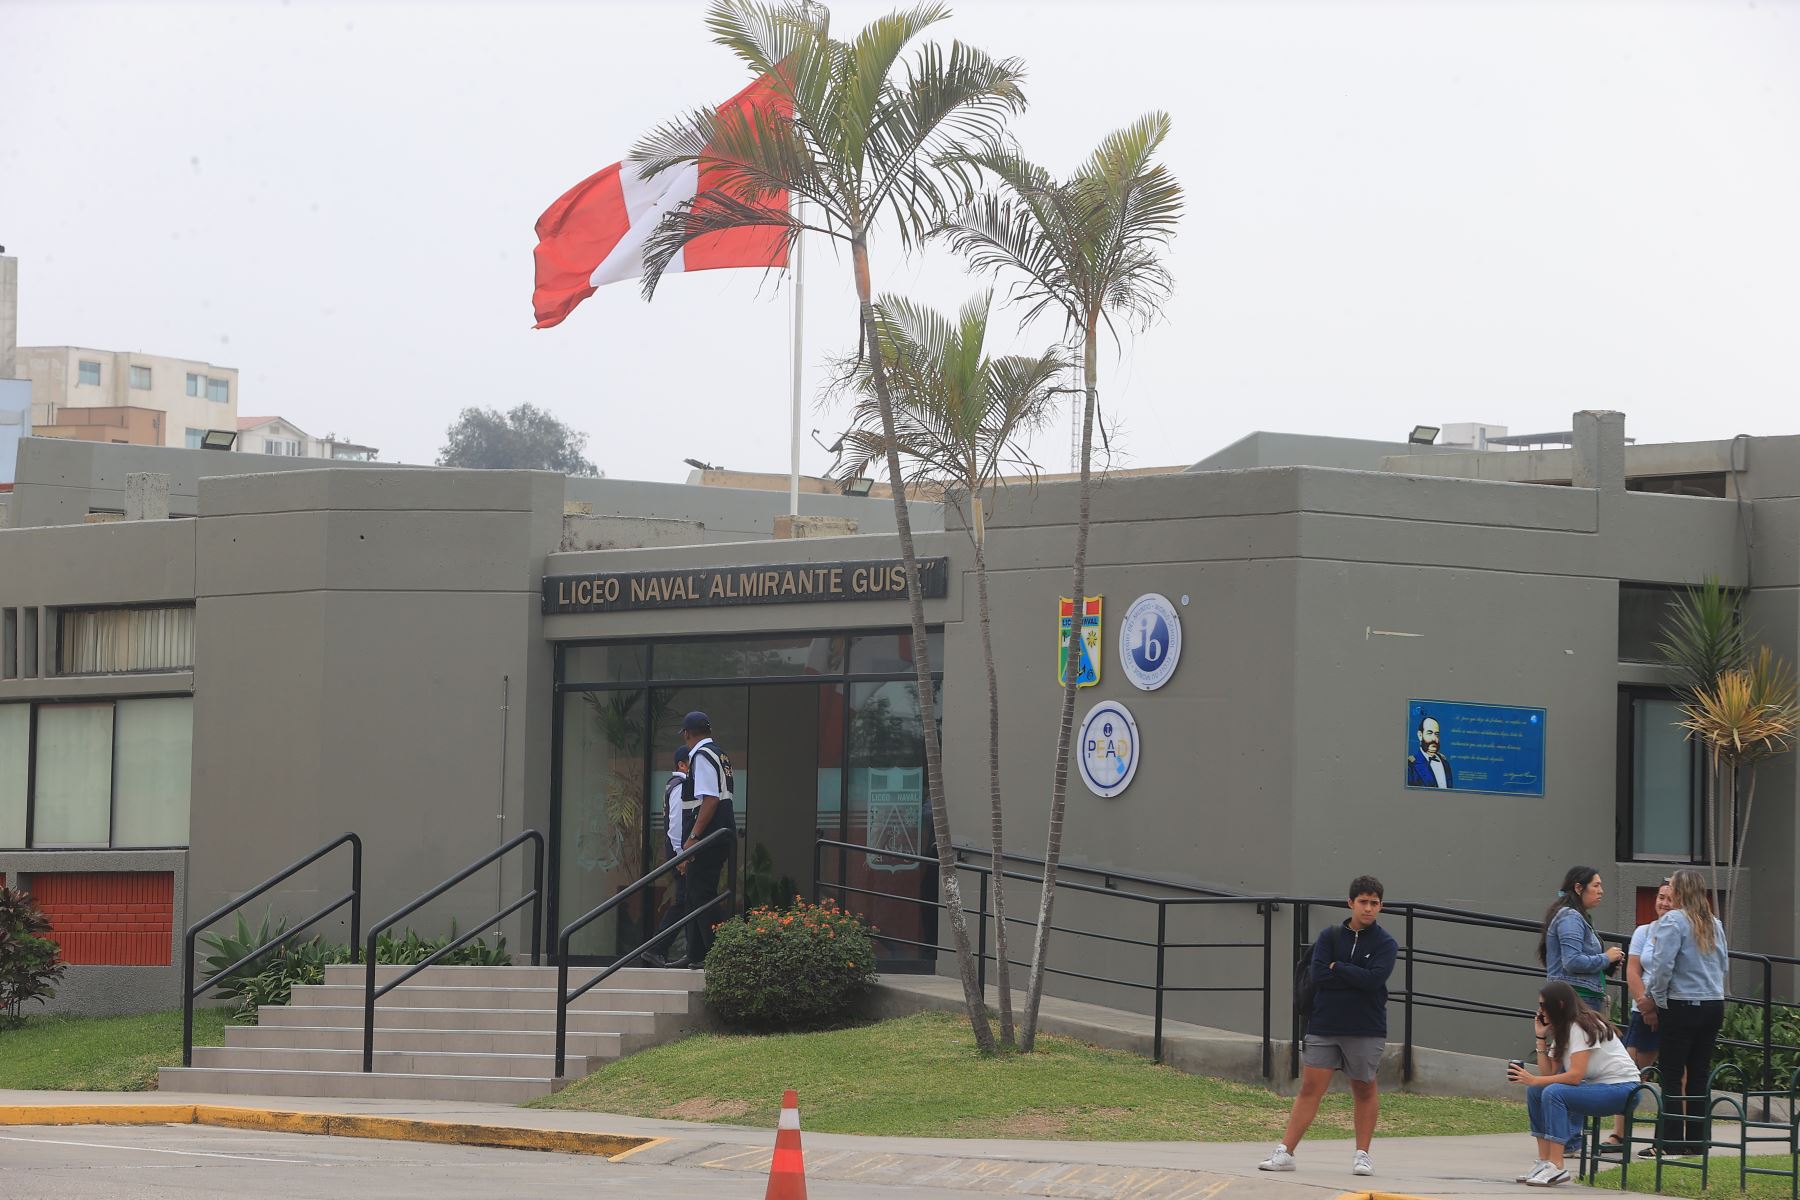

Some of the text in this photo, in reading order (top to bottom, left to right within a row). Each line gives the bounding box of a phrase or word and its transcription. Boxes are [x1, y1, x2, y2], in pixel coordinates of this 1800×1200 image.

[559, 577, 621, 605] LICEO
[630, 575, 700, 602] NAVAL
[871, 793, 919, 801] LICEO NAVAL
